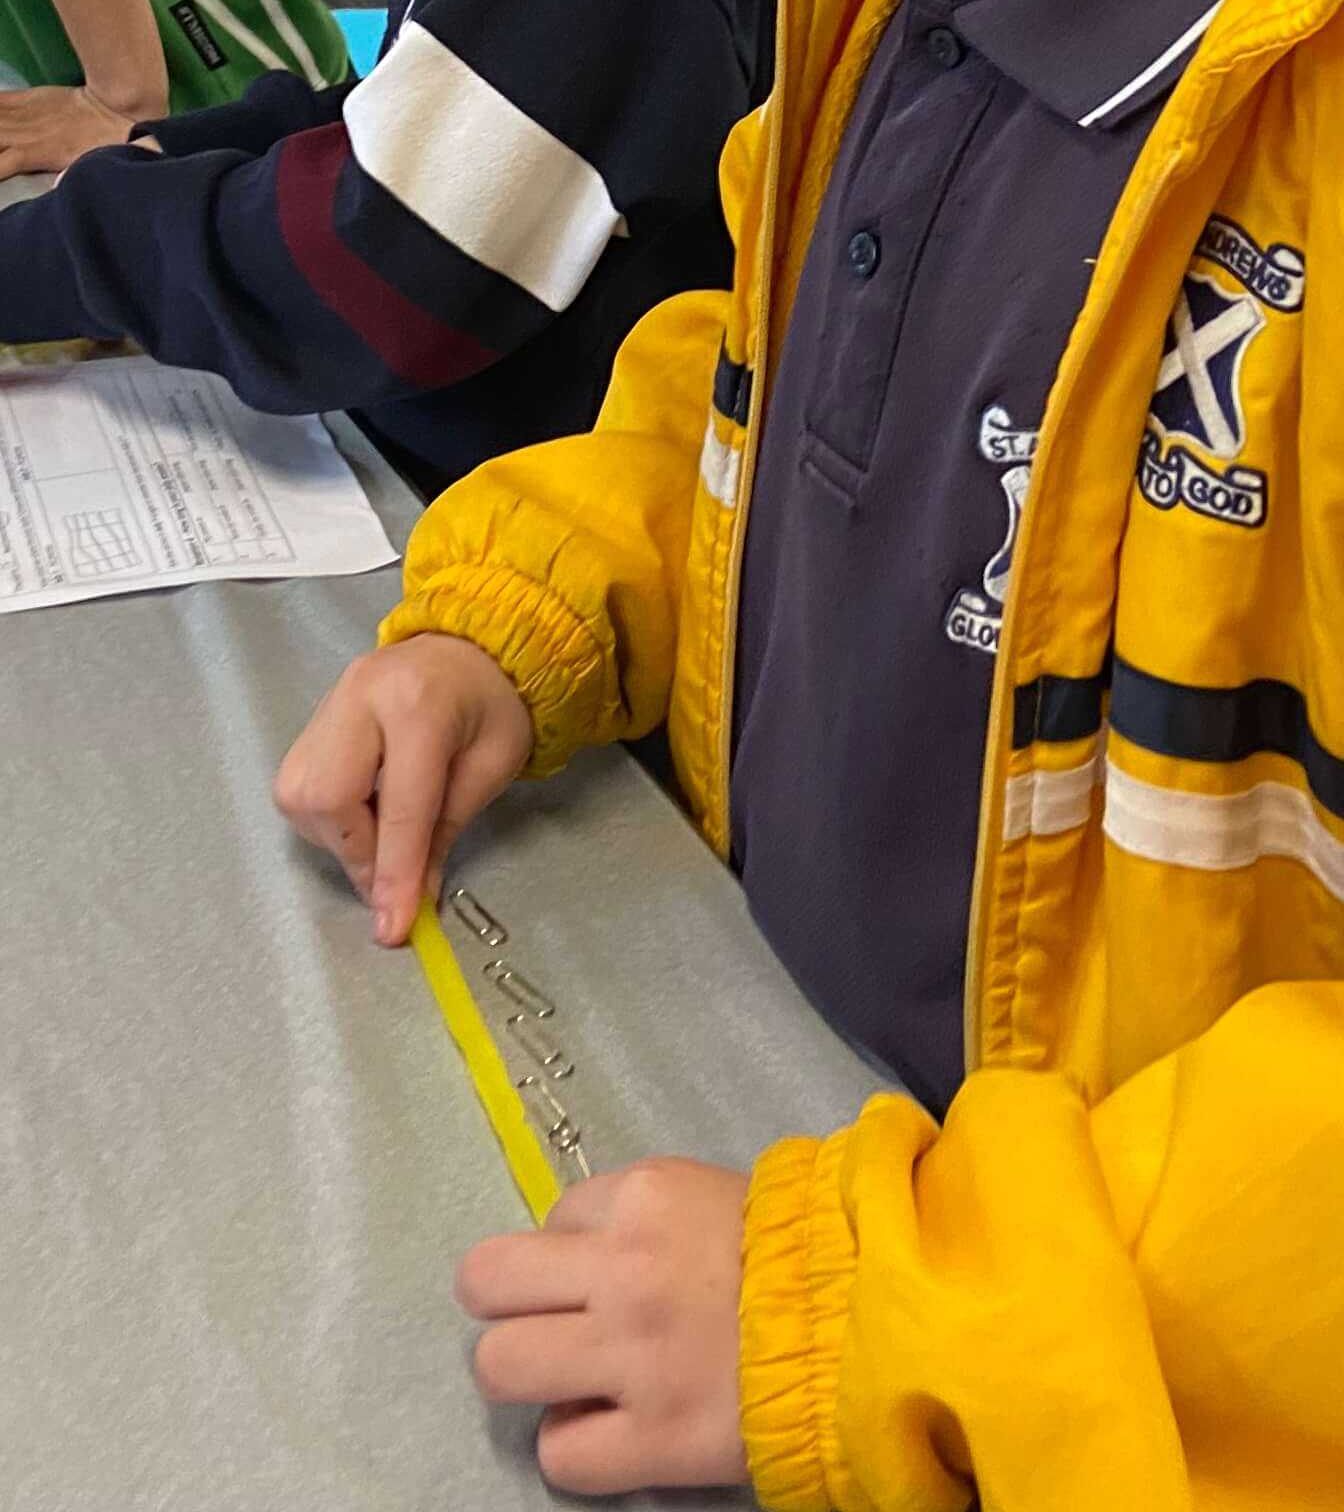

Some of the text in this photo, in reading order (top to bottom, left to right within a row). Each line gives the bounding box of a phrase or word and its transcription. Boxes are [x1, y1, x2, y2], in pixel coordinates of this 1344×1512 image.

[1146, 461, 1253, 516] TO GOD
[950, 614, 1002, 649] GLO
